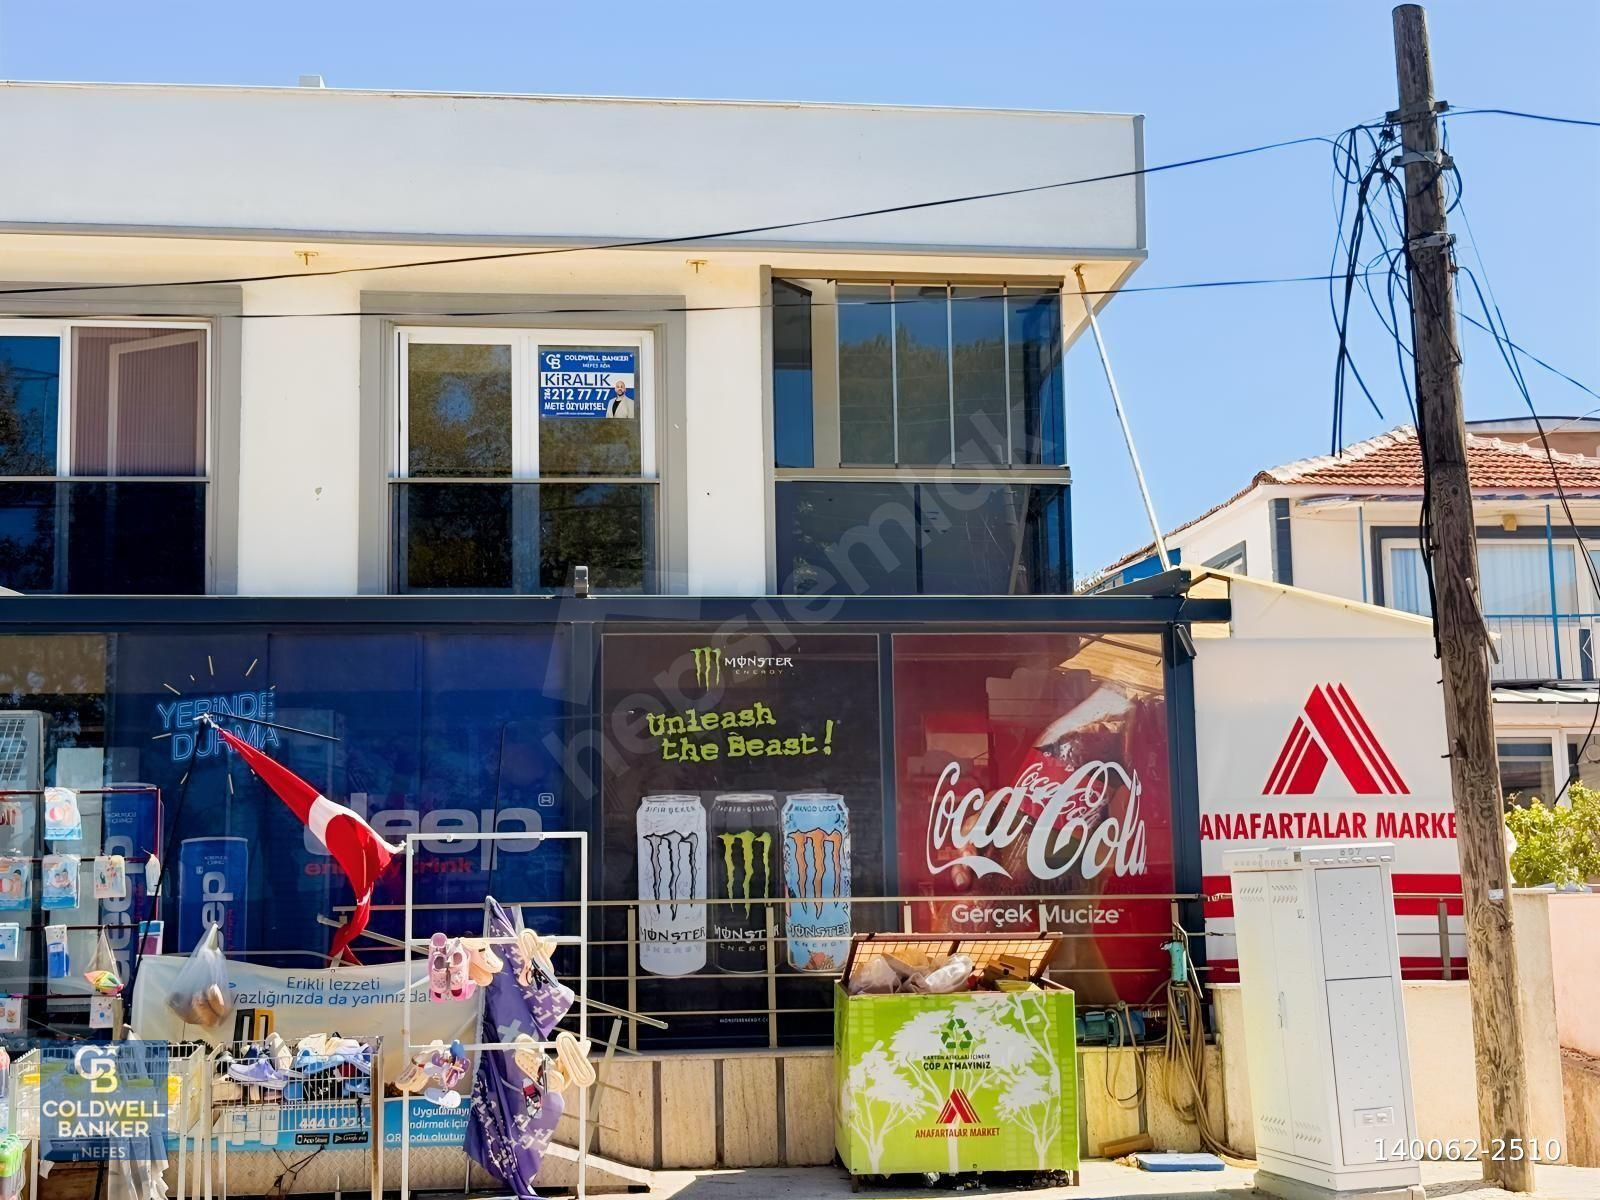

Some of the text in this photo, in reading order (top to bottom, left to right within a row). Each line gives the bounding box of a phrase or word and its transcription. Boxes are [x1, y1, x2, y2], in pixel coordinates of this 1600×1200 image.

[552, 388, 574, 400] 212
[578, 388, 592, 400] 77
[596, 388, 610, 400] 77
[544, 401, 606, 410] METE ÖZYURTSEL
[646, 702, 776, 736] Unleash
[662, 736, 720, 763] the
[1200, 812, 1458, 840] ANAFARTALAR MARKE
[952, 904, 1032, 928] Gerçek
[714, 922, 780, 942] MONSTR
[720, 944, 768, 952] ENERG
[287, 976, 380, 990] Erikli lezzeti
[328, 992, 347, 1005] da
[943, 1061, 991, 1070] ATMAYINIZ
[410, 1120, 449, 1129] ndirmek
[386, 1134, 402, 1142] QR
[410, 1132, 428, 1141] odu
[915, 1128, 1000, 1138] ANAFARTALAR MARKET
